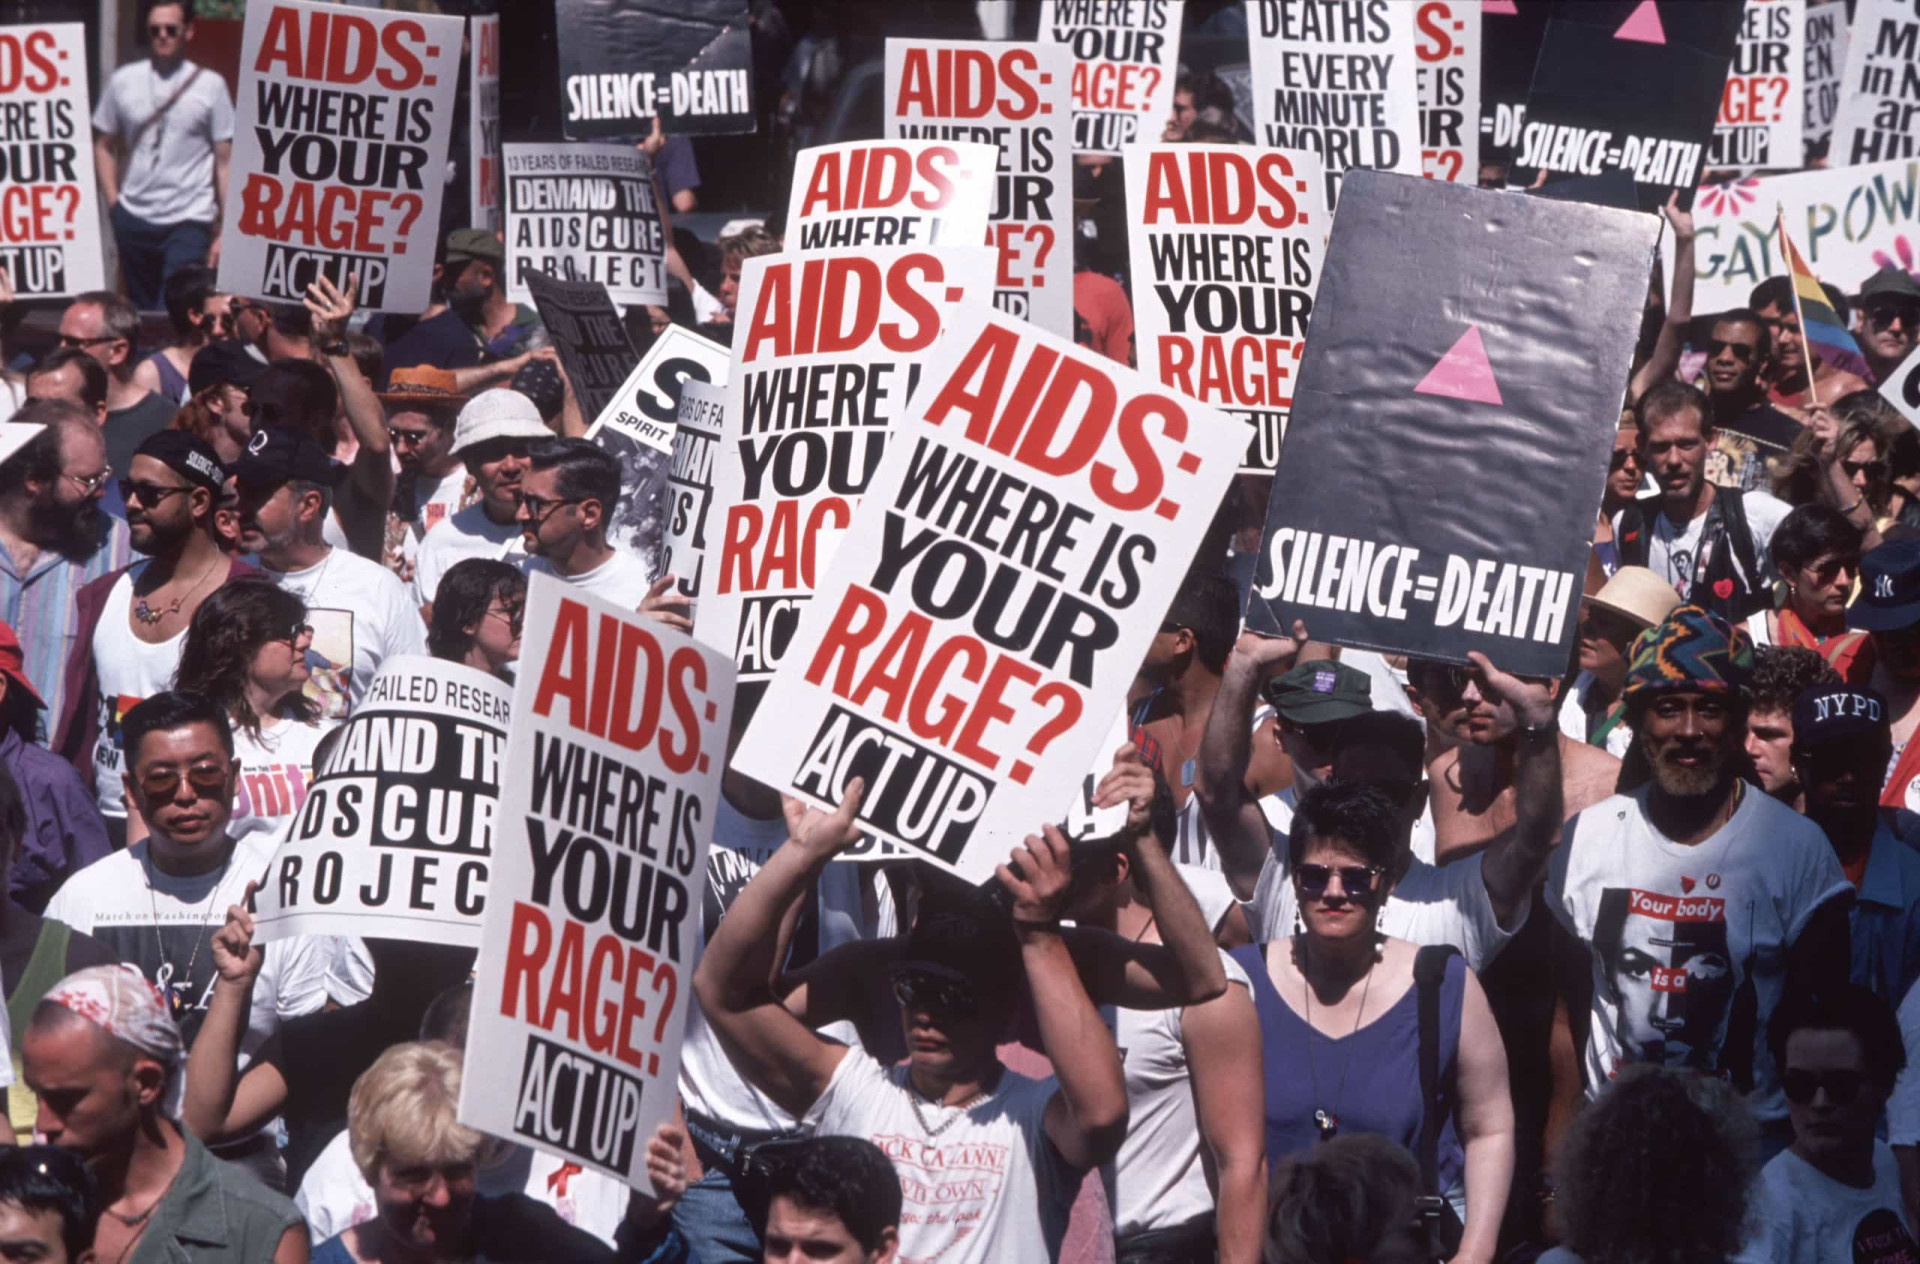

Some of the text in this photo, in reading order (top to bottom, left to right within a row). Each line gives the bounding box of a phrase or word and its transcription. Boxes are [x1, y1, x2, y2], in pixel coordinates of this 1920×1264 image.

[1053, 0, 1168, 30] WHERE IS
[1259, 0, 1391, 43] DEATHS
[254, 6, 440, 91] AIDS:
[1282, 50, 1394, 91] EVERY
[257, 80, 434, 144] WHERE IS
[896, 47, 1053, 121] AIDS:
[1274, 89, 1386, 128] MINUTE
[1435, 67, 1465, 107] IS
[46, 99, 74, 140] IS
[1265, 123, 1400, 170] WORLD
[254, 126, 429, 190] YOUR
[520, 155, 556, 171] YEARS
[558, 154, 574, 170] OF
[1515, 121, 1702, 188] SILENCE=DEATH
[237, 172, 424, 255] RAGE?
[515, 177, 618, 211] DEMAND
[1143, 151, 1309, 229] AIDS:
[516, 216, 663, 252] AIDS CURE
[1693, 162, 1920, 286] GAY POW
[24, 248, 64, 293] UP
[1149, 233, 1312, 287] WHERE IS
[1153, 283, 1313, 338] YOUR
[614, 411, 670, 443] SPIRIT
[742, 362, 895, 436] WHERE
[922, 321, 1203, 522] AIDS:
[738, 430, 893, 501] YOU
[893, 436, 1095, 587] WHERE
[1079, 522, 1157, 611] IS
[869, 509, 1120, 690] YOUR
[1260, 527, 1575, 645] SILENCE=DEATH
[370, 674, 438, 704] FAILED
[533, 597, 718, 775] AIDS:
[803, 582, 1084, 786] RAGE?
[1814, 692, 1881, 722] NYPD
[531, 730, 667, 860] WHERE
[666, 788, 701, 877] IS
[795, 712, 989, 855] ACT UP
[525, 815, 689, 963] YOUR
[1630, 891, 1723, 922] Your body
[499, 901, 678, 1078] RAGE?
[1653, 968, 1686, 988] is a
[515, 1042, 641, 1168] ACT UP
